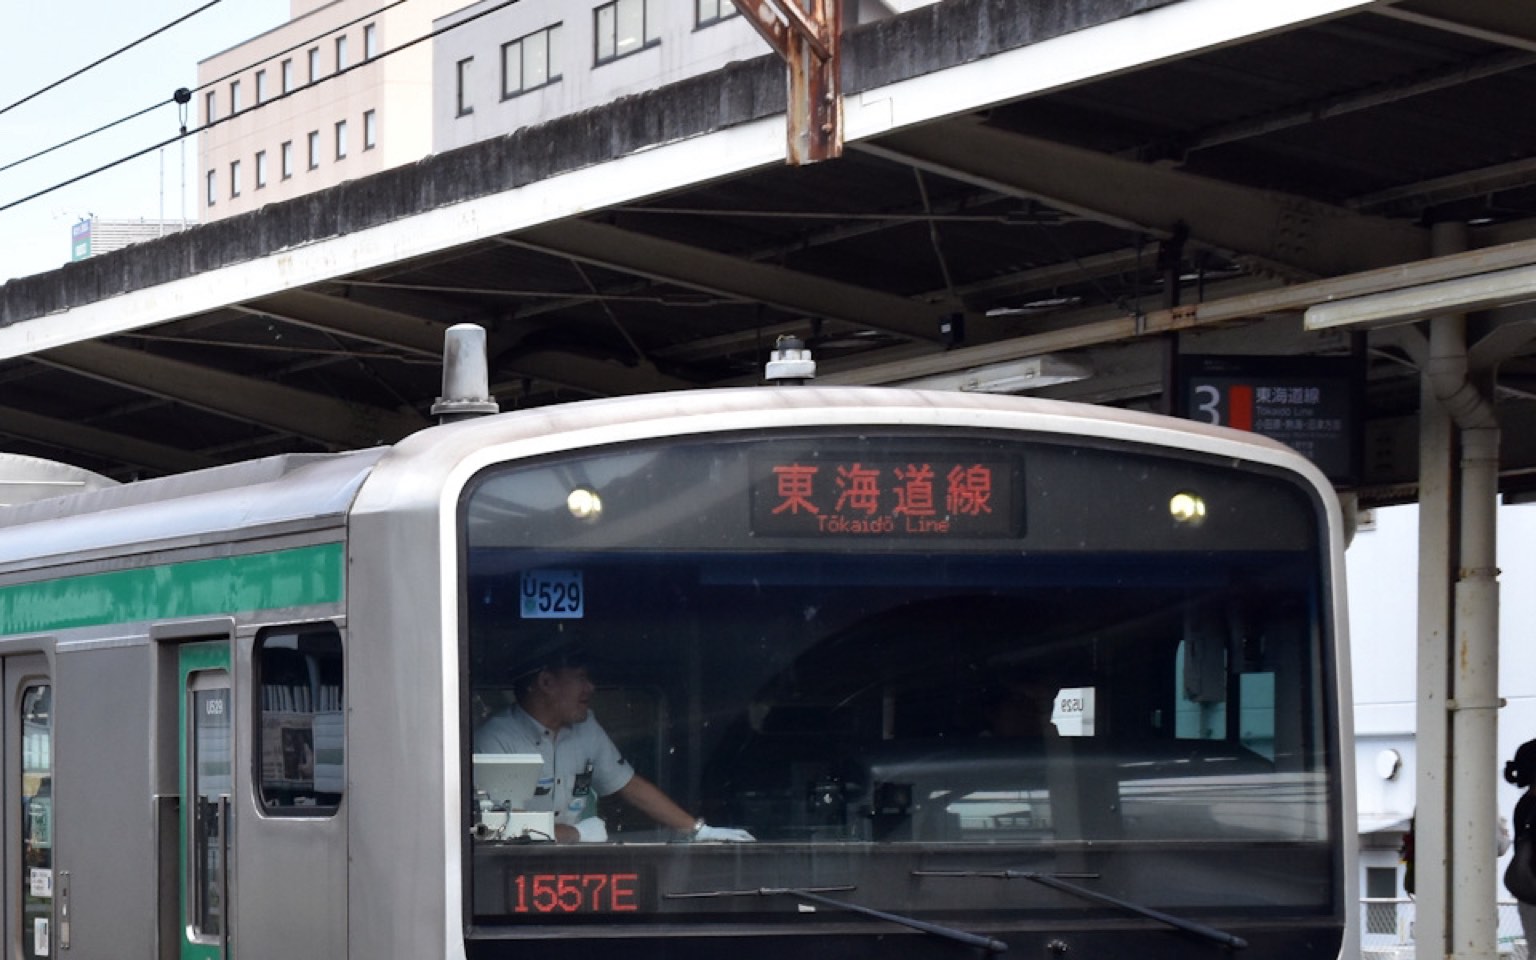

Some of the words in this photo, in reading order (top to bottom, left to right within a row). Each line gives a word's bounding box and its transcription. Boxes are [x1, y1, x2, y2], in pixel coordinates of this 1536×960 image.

[1195, 385, 1220, 427] 3
[1255, 386, 1320, 404] 東海道線
[771, 463, 993, 516] 東海道線
[906, 515, 950, 533] Line
[515, 874, 638, 912] 1557E
